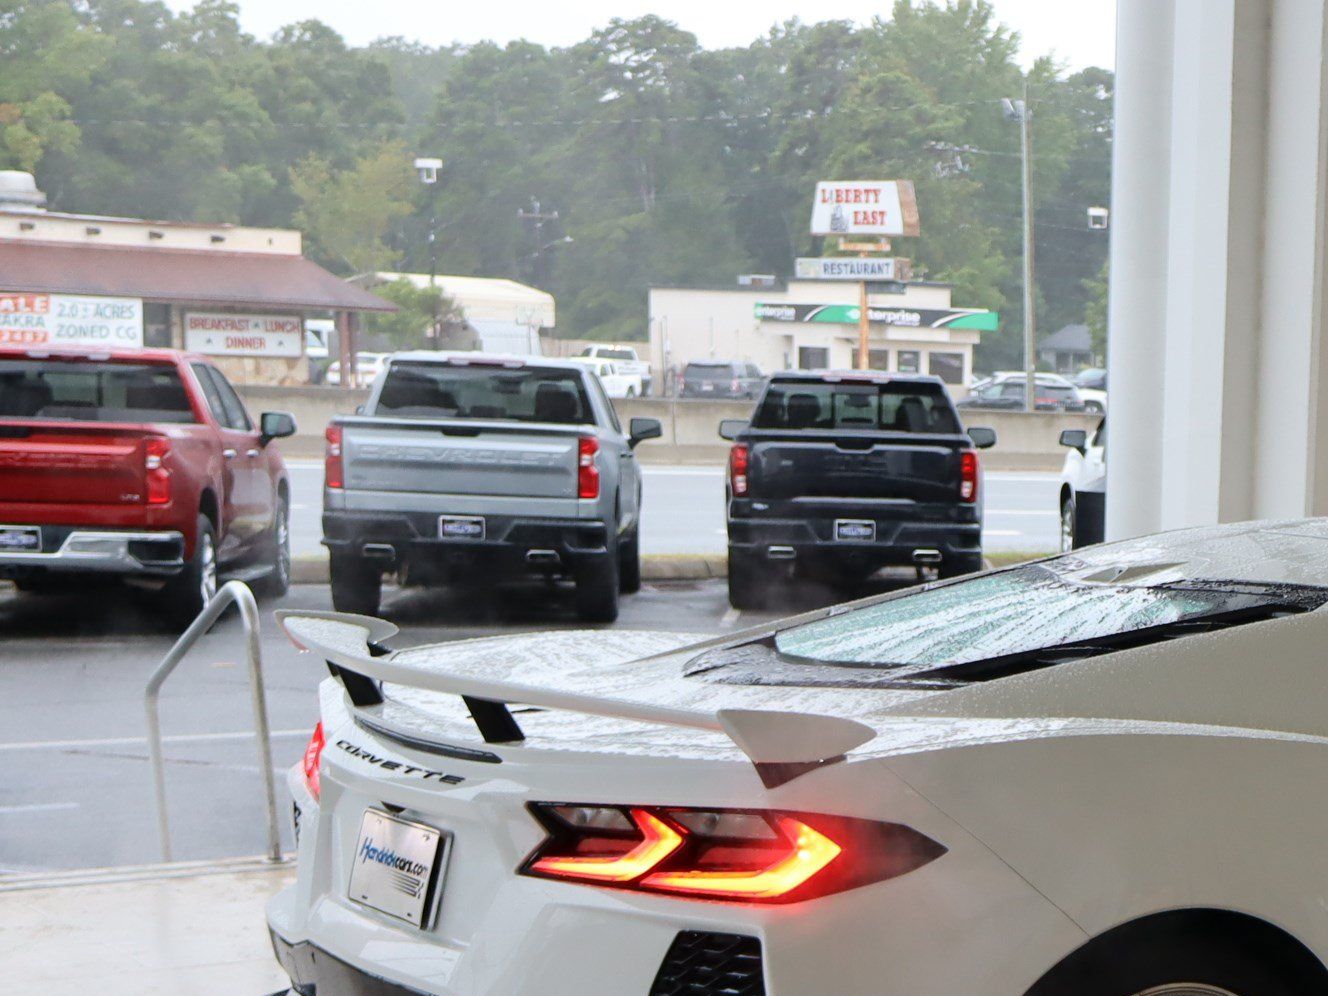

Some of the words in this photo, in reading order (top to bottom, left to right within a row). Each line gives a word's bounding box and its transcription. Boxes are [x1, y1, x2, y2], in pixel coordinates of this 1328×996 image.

[853, 211, 886, 226] EAST
[823, 262, 891, 276] RESTAURANT
[94, 303, 135, 319] ACRES
[846, 308, 920, 323] eterprise
[56, 324, 110, 339] ZONED
[189, 318, 249, 331] BREAKFAST
[265, 319, 300, 333] LUNCH
[226, 336, 266, 349] DINNER
[336, 739, 466, 785] CORVETTE
